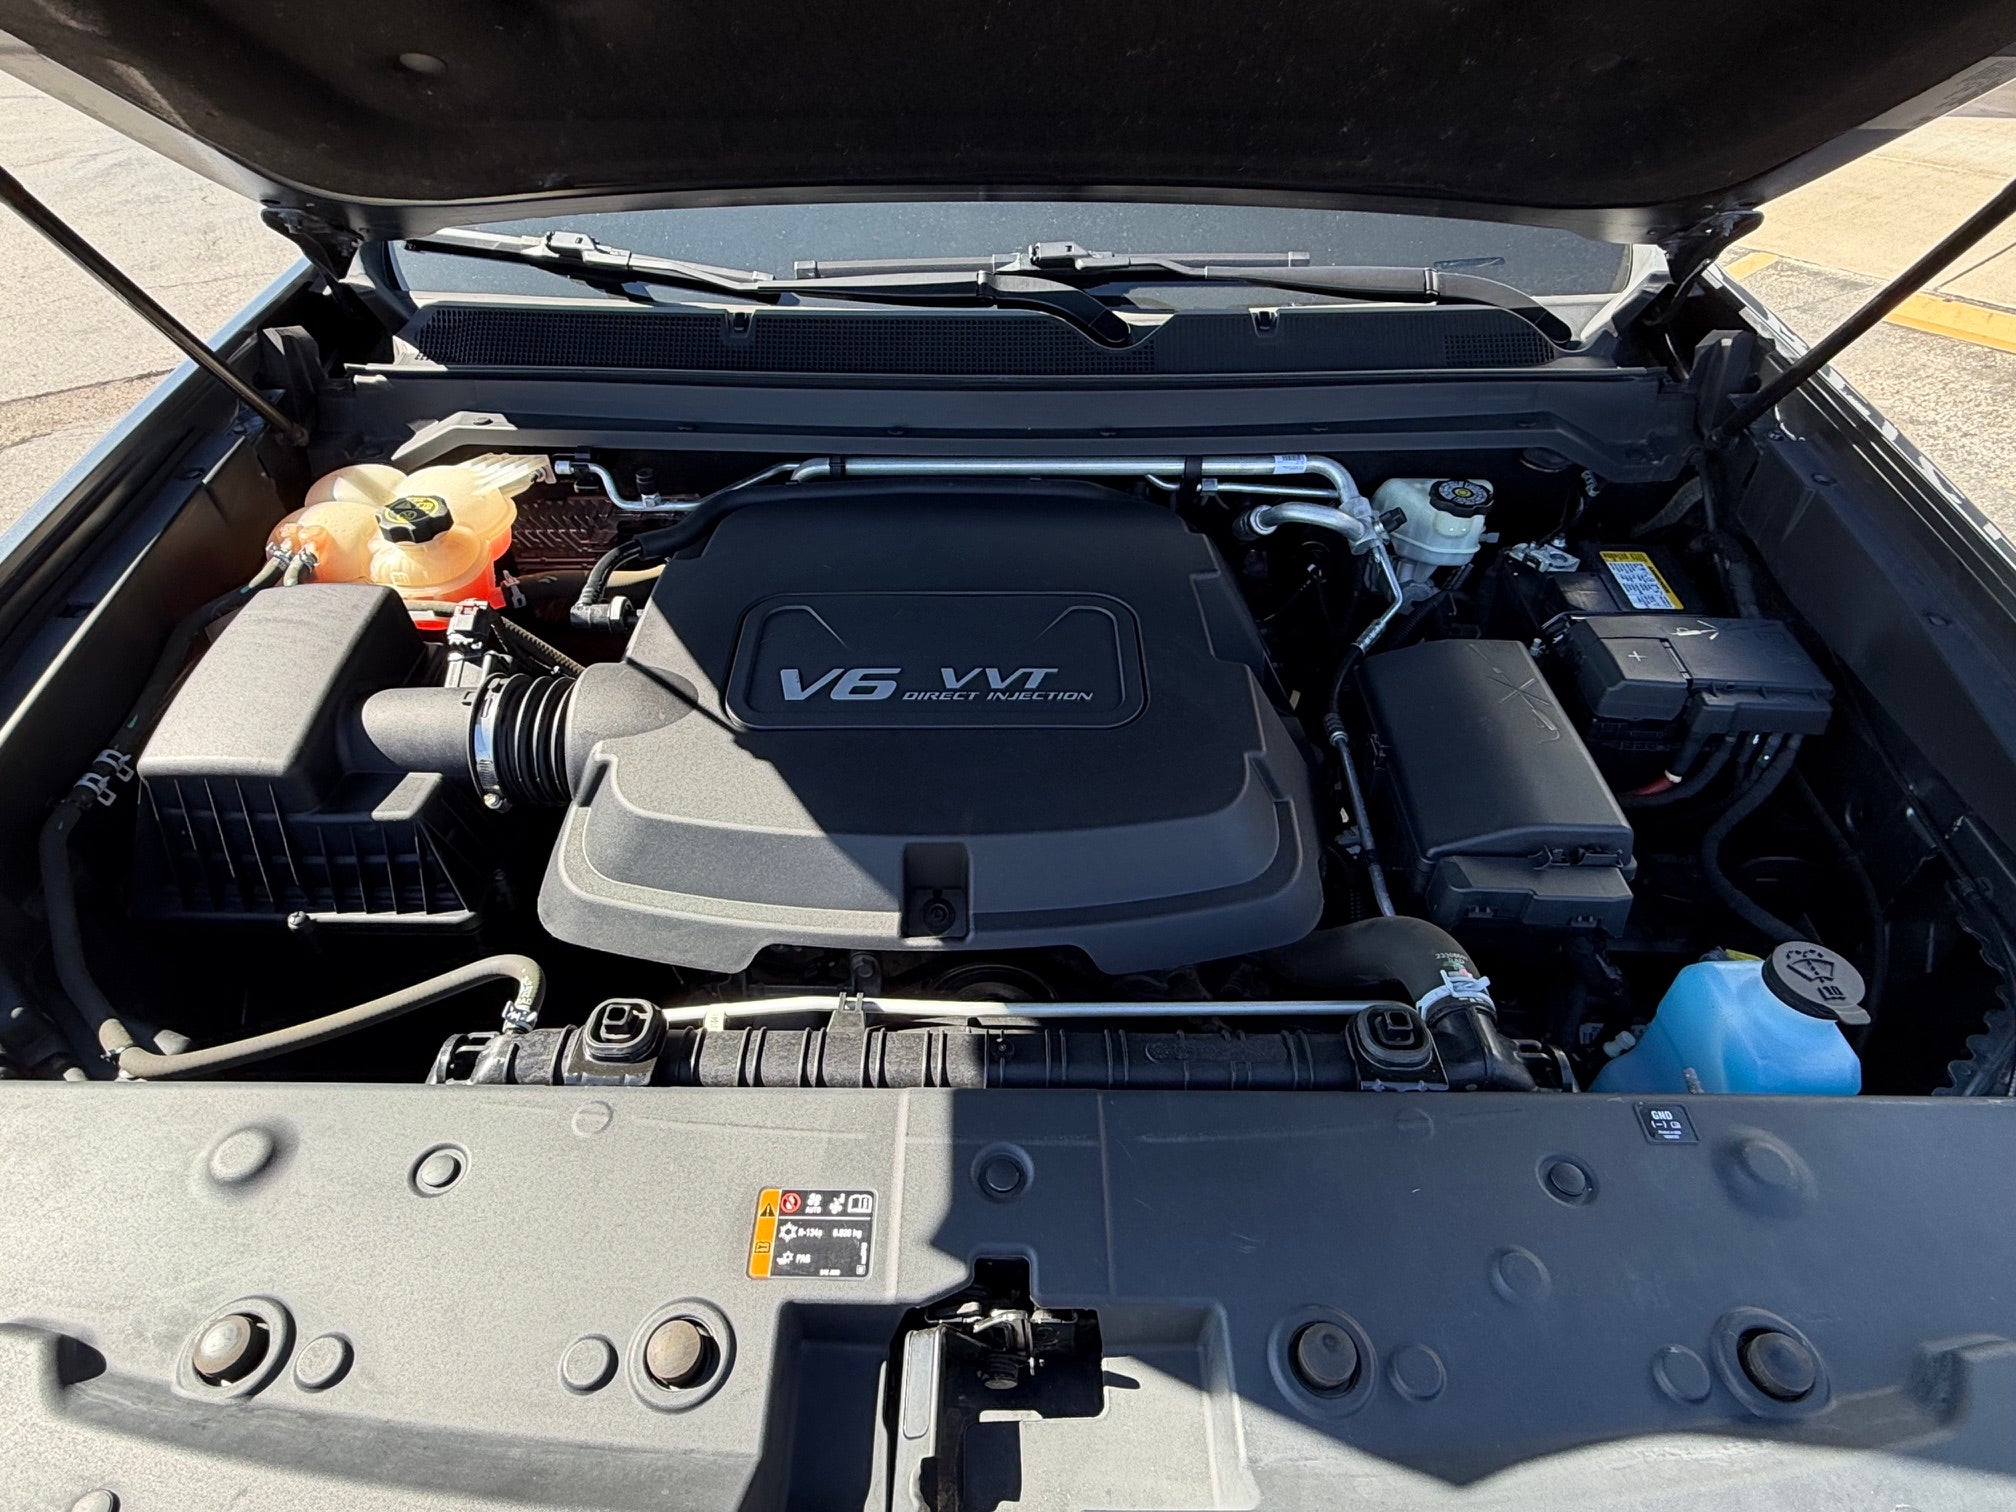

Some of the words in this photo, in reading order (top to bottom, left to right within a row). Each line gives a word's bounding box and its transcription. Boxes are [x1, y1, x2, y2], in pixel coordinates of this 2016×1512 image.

[940, 667, 1059, 690] VVT
[780, 667, 901, 701] V6
[902, 691, 980, 701] DIRECT
[985, 691, 1094, 701] INJECTION
[1650, 1110, 1673, 1120] GND
[805, 1206, 822, 1214] AUTO
